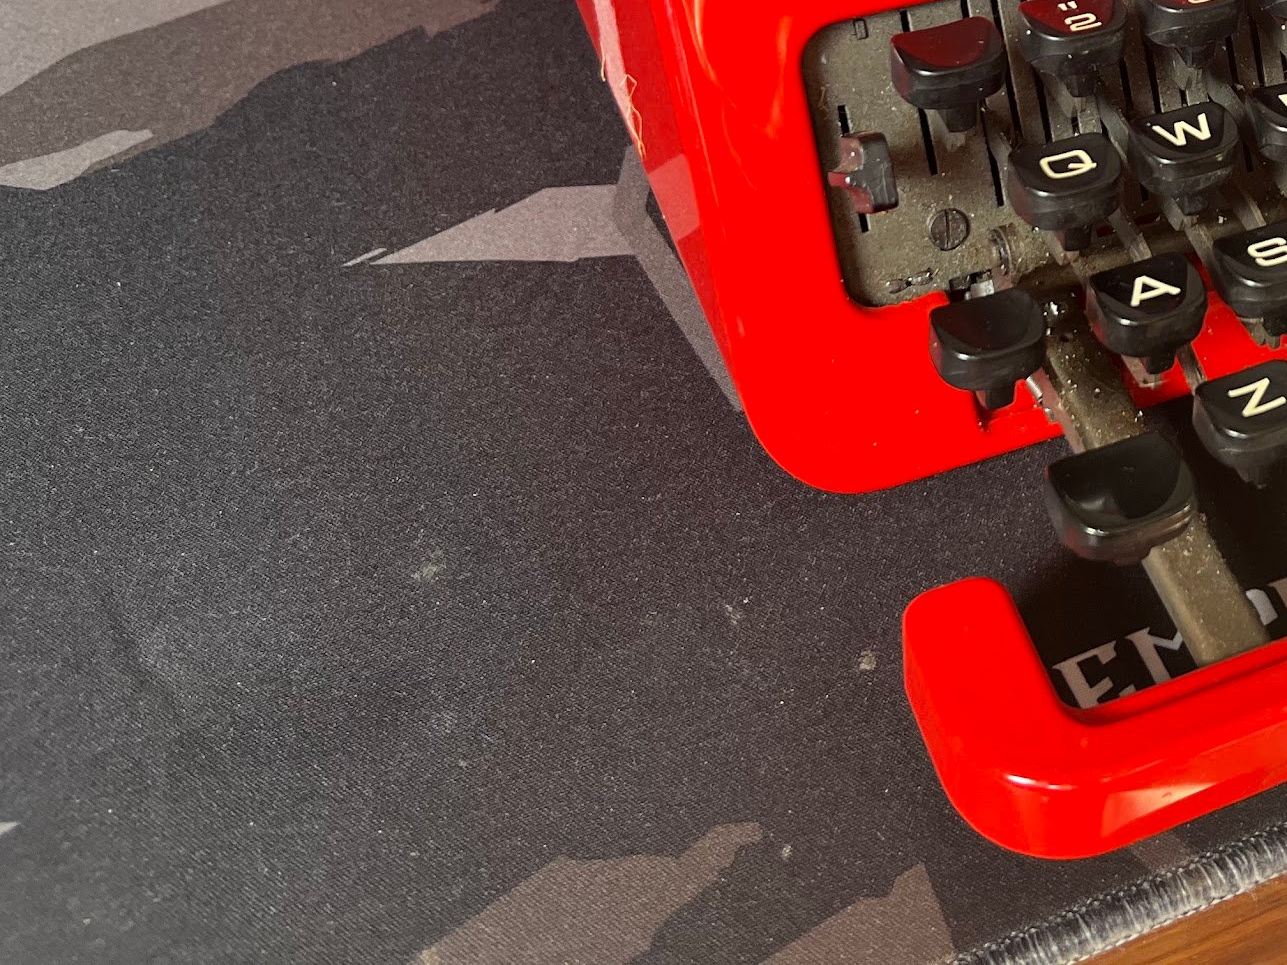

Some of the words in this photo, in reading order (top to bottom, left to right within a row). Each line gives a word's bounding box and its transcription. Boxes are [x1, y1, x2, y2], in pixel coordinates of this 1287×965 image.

[1065, 13, 1102, 31] 2
[1152, 113, 1212, 146] W
[1039, 149, 1097, 179] Q
[1130, 275, 1181, 307] A
[1227, 377, 1287, 418] Z
